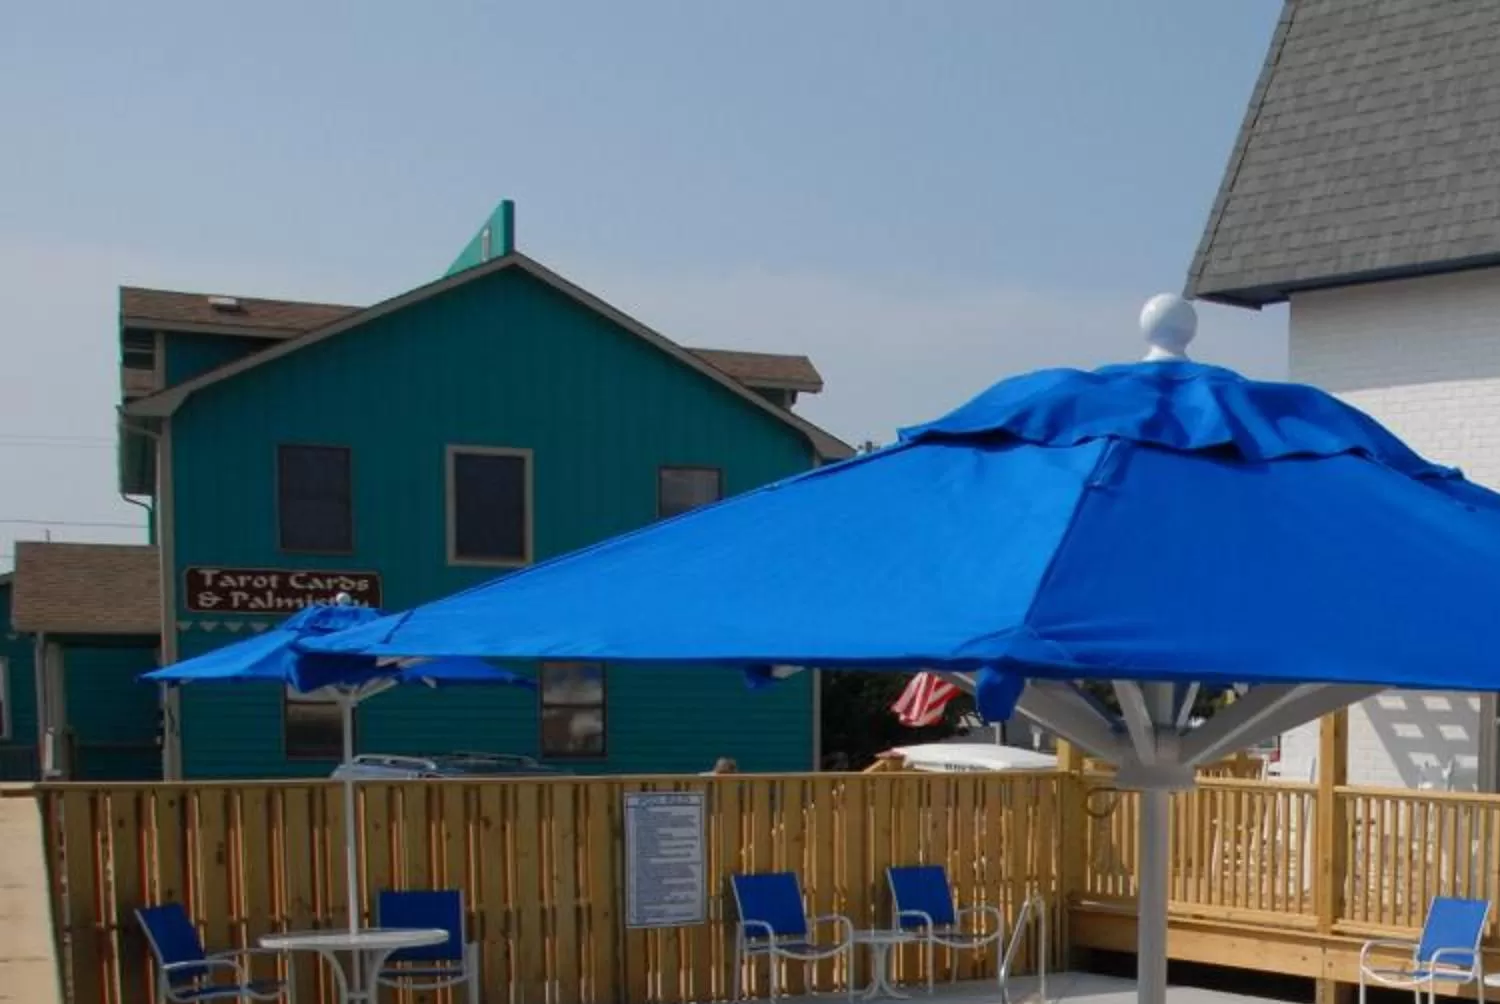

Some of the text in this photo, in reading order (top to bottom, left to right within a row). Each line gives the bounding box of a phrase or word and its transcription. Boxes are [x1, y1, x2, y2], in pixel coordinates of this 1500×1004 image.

[197, 569, 369, 591] Tarot Cards
[197, 591, 223, 608] &
